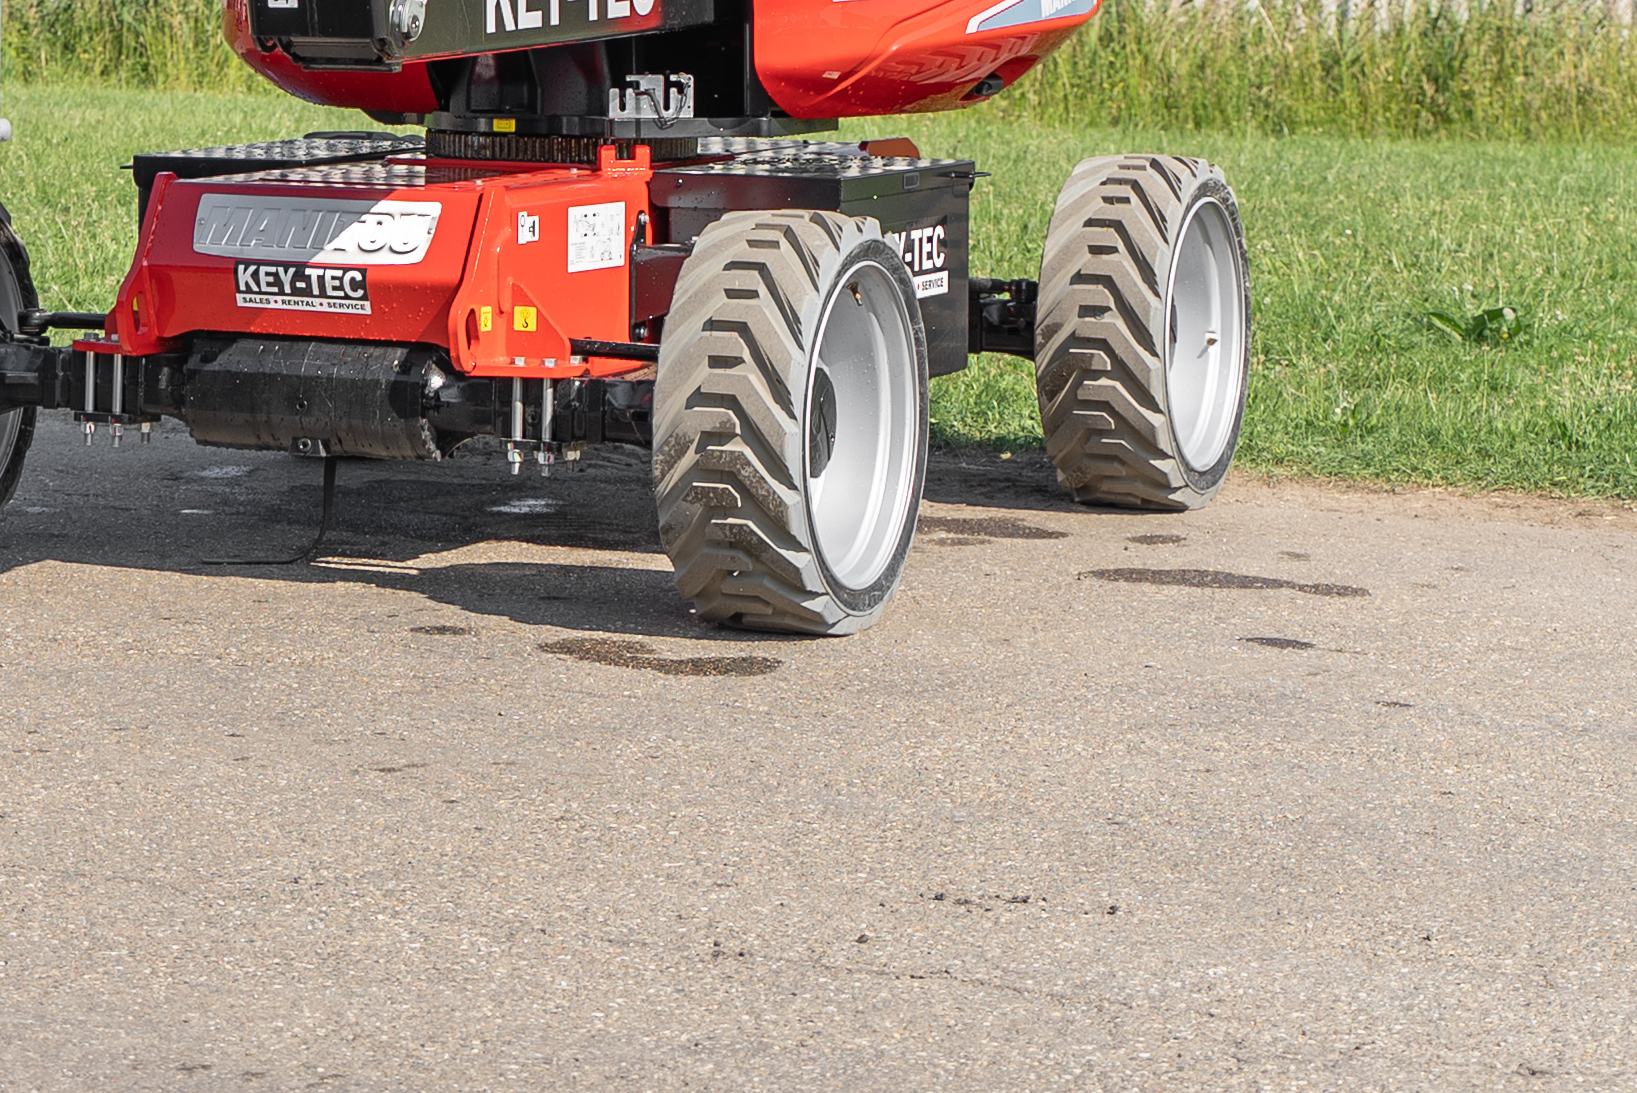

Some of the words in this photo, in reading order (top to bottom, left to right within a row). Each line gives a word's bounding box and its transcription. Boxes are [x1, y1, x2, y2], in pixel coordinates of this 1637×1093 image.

[197, 206, 434, 254] MANITOU
[236, 264, 364, 298] KEY-TEC
[921, 277, 944, 292] SERVICE
[241, 296, 271, 305] SALES
[280, 298, 317, 308] RENTAL
[326, 301, 367, 311] SERVICE
